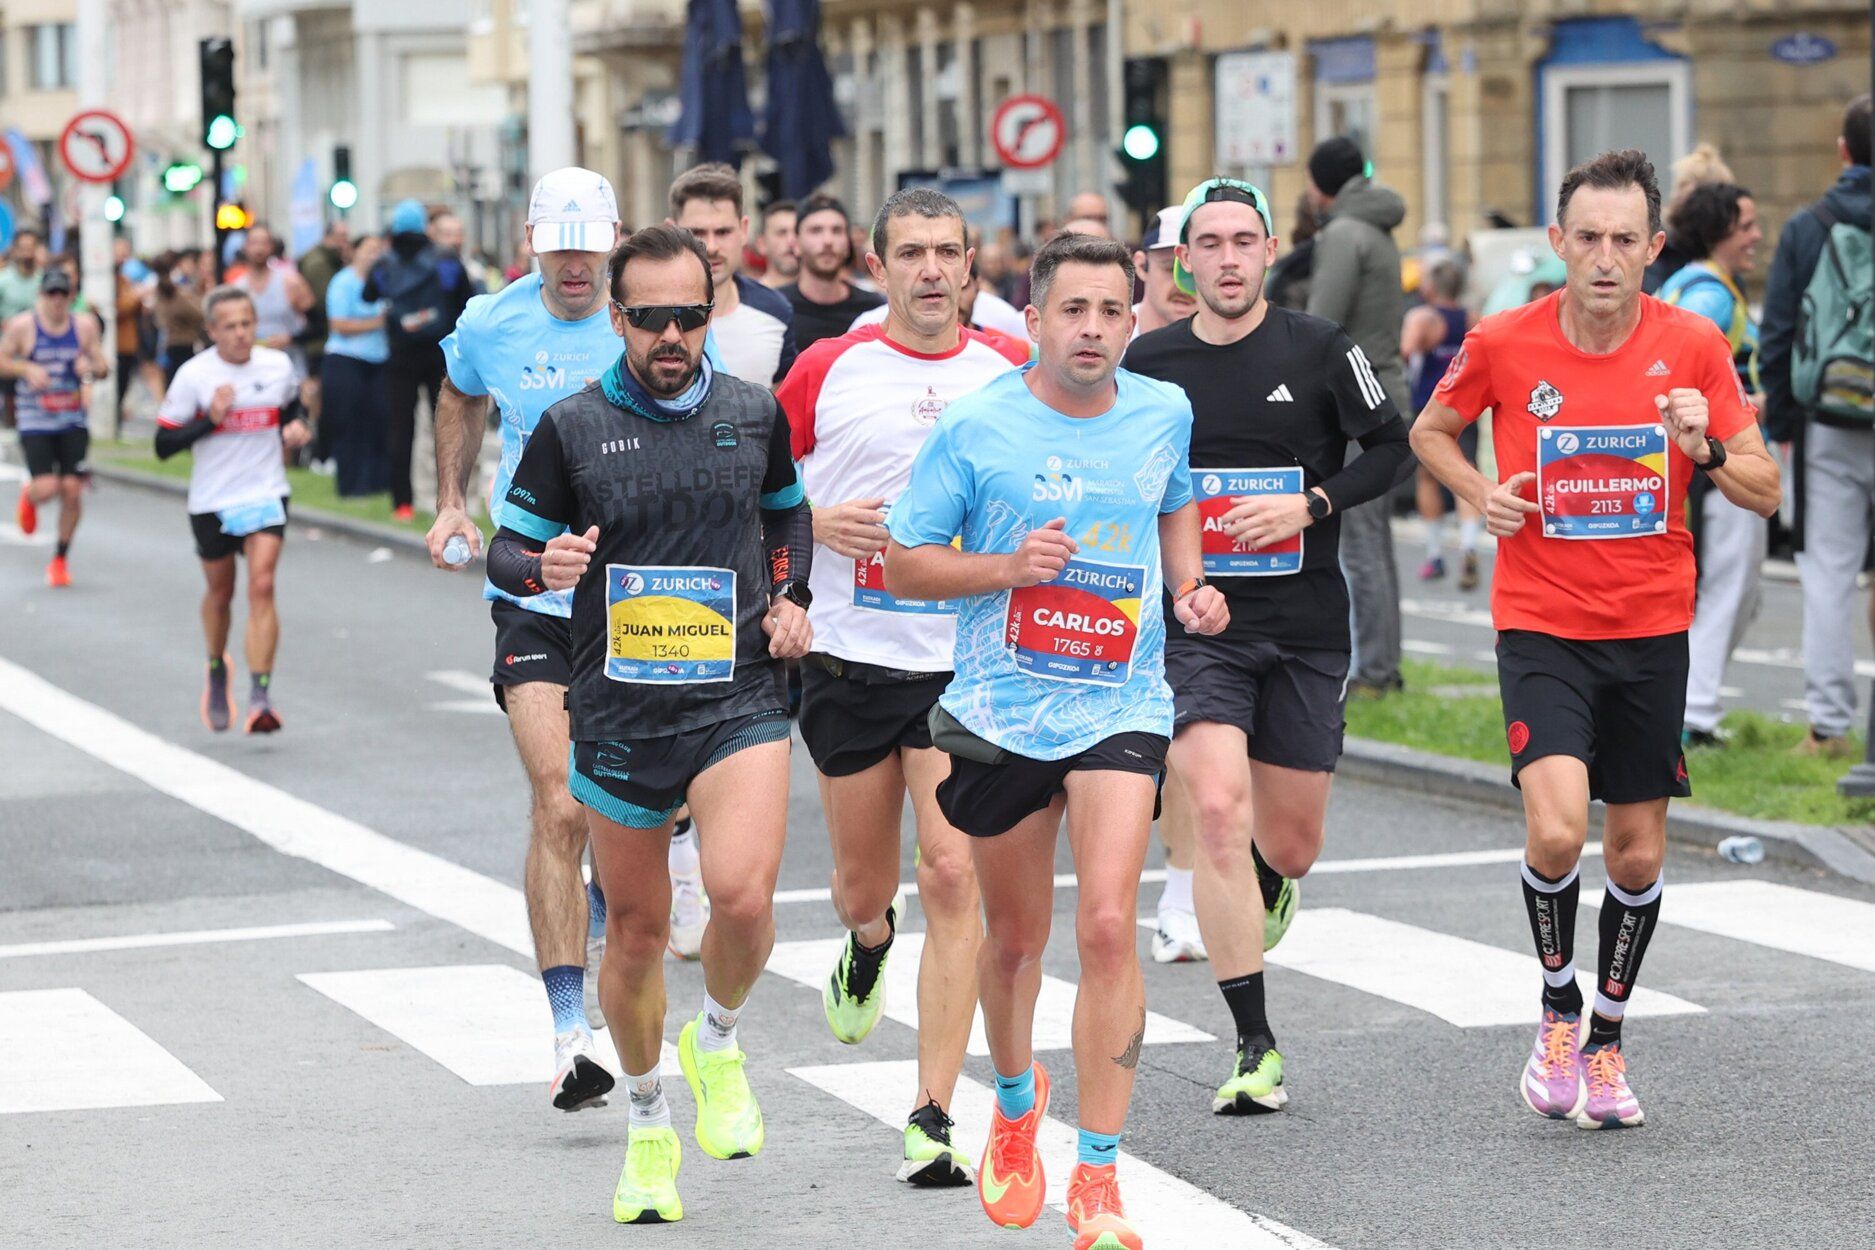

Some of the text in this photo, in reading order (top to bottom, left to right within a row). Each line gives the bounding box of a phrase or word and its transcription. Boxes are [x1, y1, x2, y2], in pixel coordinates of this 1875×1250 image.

[552, 353, 590, 361] ZURICH
[601, 437, 640, 455] GOBIK
[1586, 435, 1646, 449] ZURICH
[1066, 459, 1109, 469] ZURICH
[1227, 478, 1284, 490] ZURICH
[1555, 476, 1662, 493] GUILLERMO
[1545, 494, 1555, 514] 42k
[1591, 500, 1622, 513] 2113
[1081, 520, 1133, 554] 42k
[651, 578, 712, 591] ZURICH
[857, 567, 867, 586] 42k
[1064, 568, 1128, 589] ZURICH
[622, 624, 663, 636] JUAN
[668, 624, 729, 636] MIGUEL
[1033, 608, 1126, 636] CARLOS
[1011, 621, 1020, 642] 42k
[652, 644, 690, 658] 1340
[1053, 637, 1091, 656] 1765
